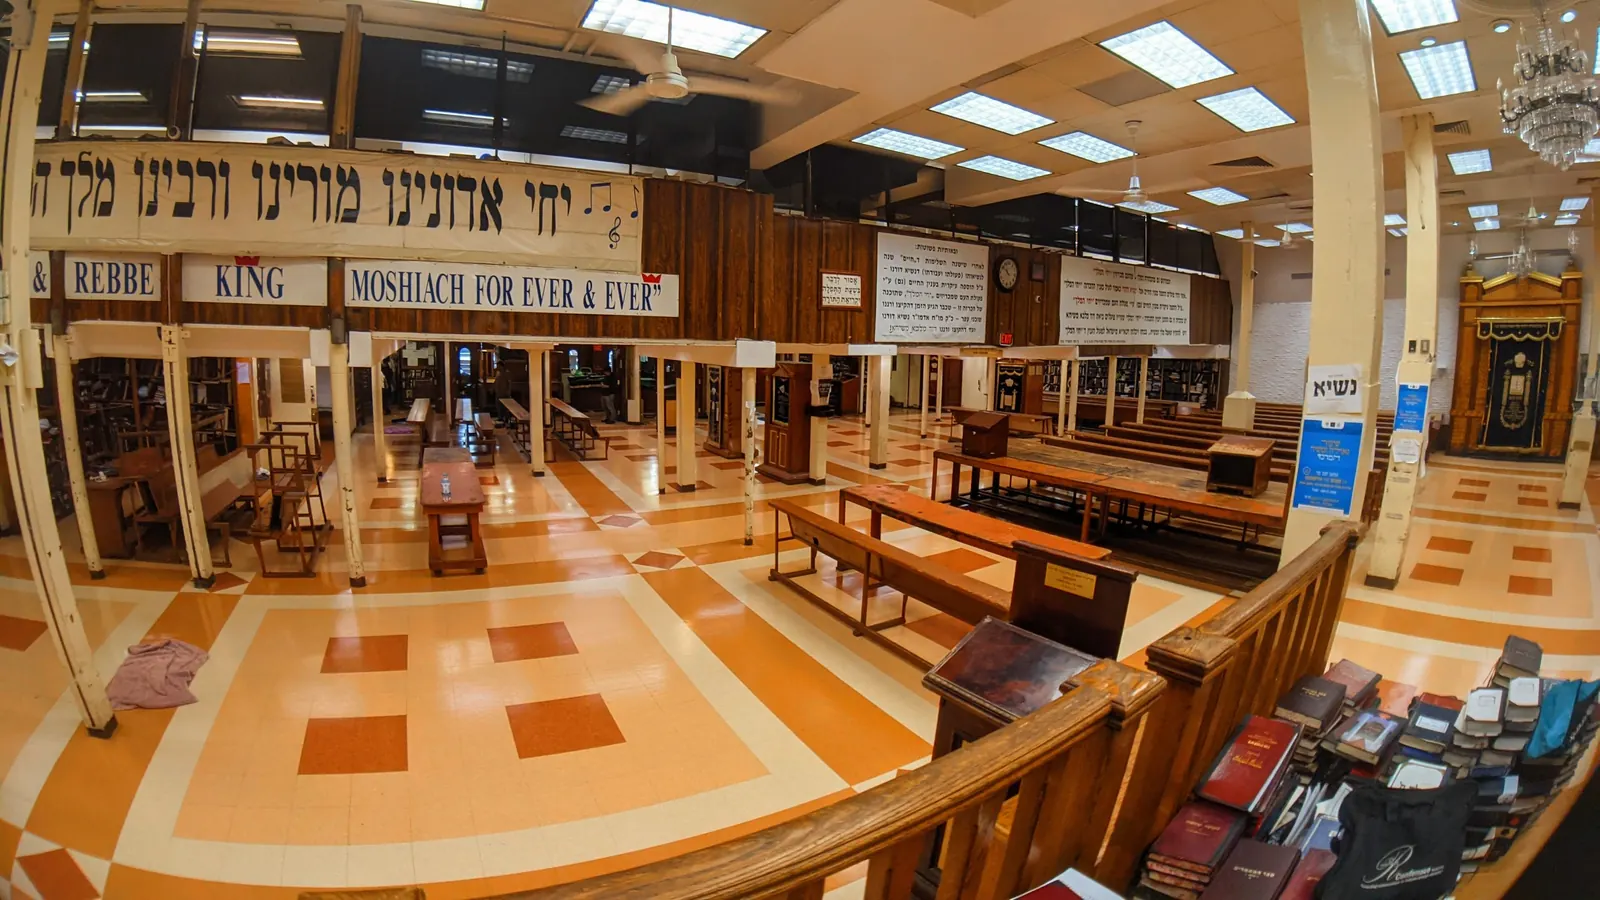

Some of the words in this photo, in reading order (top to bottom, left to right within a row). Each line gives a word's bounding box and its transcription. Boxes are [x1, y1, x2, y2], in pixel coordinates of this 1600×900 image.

[31, 159, 51, 218] ה
[60, 151, 115, 236] מלך
[134, 157, 230, 220] ורבינו
[252, 160, 361, 224] מורינו
[382, 168, 504, 236] אדונינו
[525, 179, 571, 237] יחי
[33, 261, 47, 293] &
[74, 262, 154, 295] REBBE
[216, 264, 284, 299] KING
[352, 269, 465, 304] MOSHIACH
[475, 274, 514, 306] FOR
[522, 277, 574, 308] EVER
[583, 280, 596, 310] &
[1314, 379, 1357, 397] נשיא
